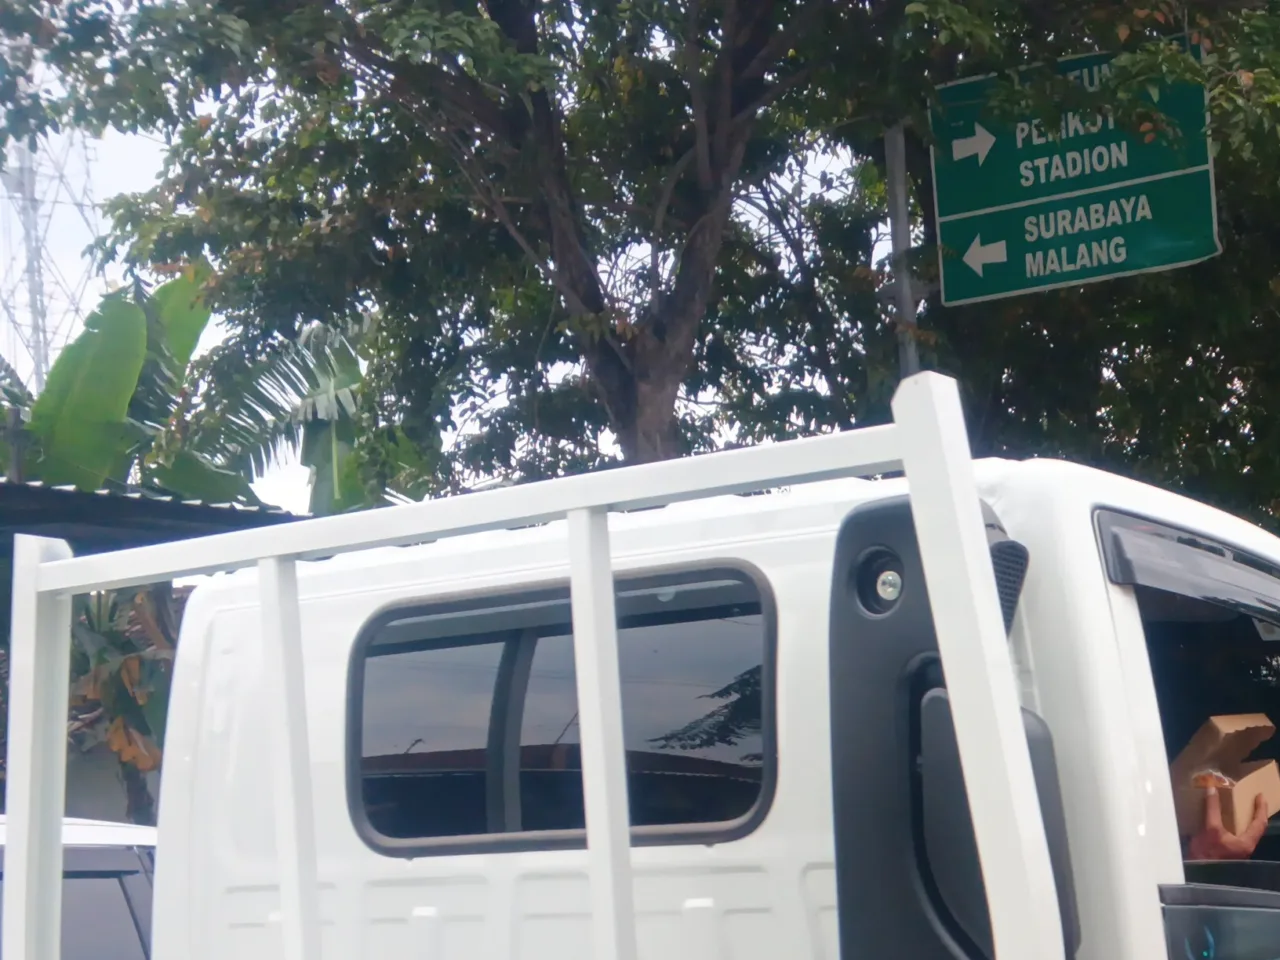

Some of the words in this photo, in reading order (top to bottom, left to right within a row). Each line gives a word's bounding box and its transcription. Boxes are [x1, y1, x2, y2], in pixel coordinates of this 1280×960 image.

[1019, 141, 1128, 187] STADION
[1024, 195, 1152, 242] SURABAYA
[1025, 236, 1127, 278] MALANG
